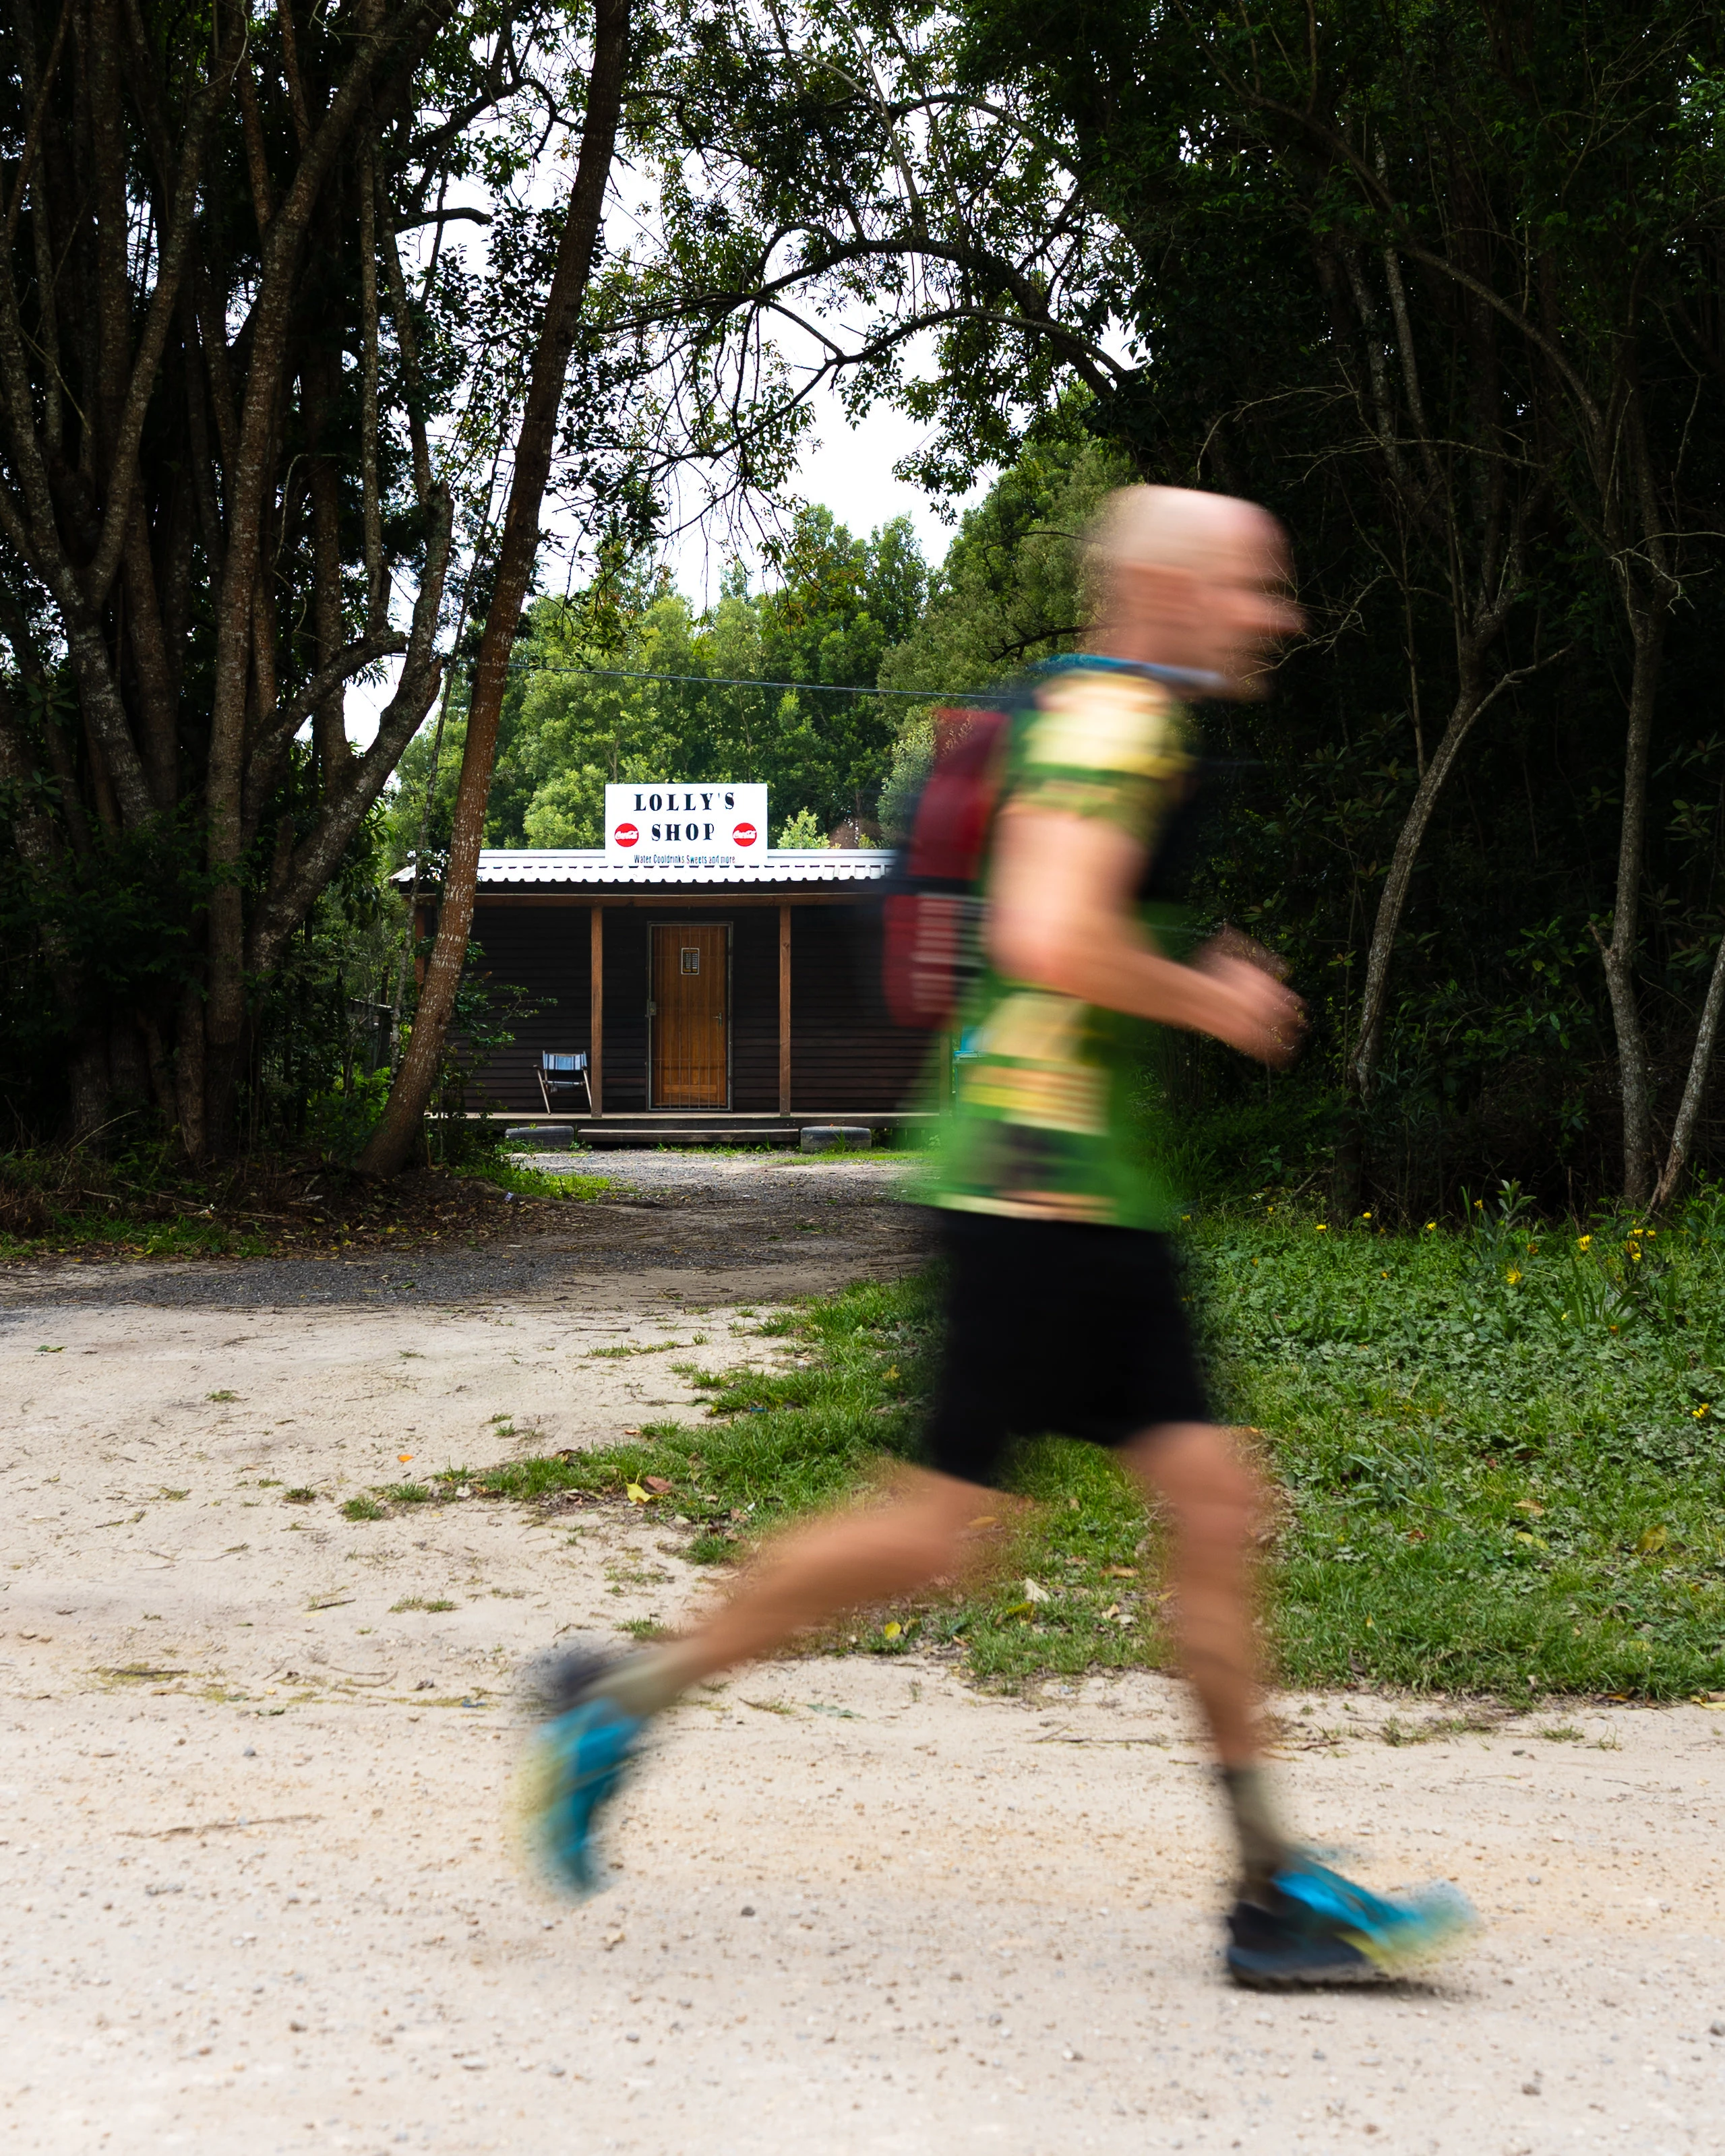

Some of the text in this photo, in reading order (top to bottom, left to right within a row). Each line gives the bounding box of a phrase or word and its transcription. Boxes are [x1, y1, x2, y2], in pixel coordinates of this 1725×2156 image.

[634, 792, 735, 811] LOLLY'S
[651, 824, 715, 841] SHOP
[634, 855, 651, 863] Water
[653, 854, 684, 864] Cooldrinks
[686, 855, 707, 864] Sweets
[708, 855, 719, 863] and
